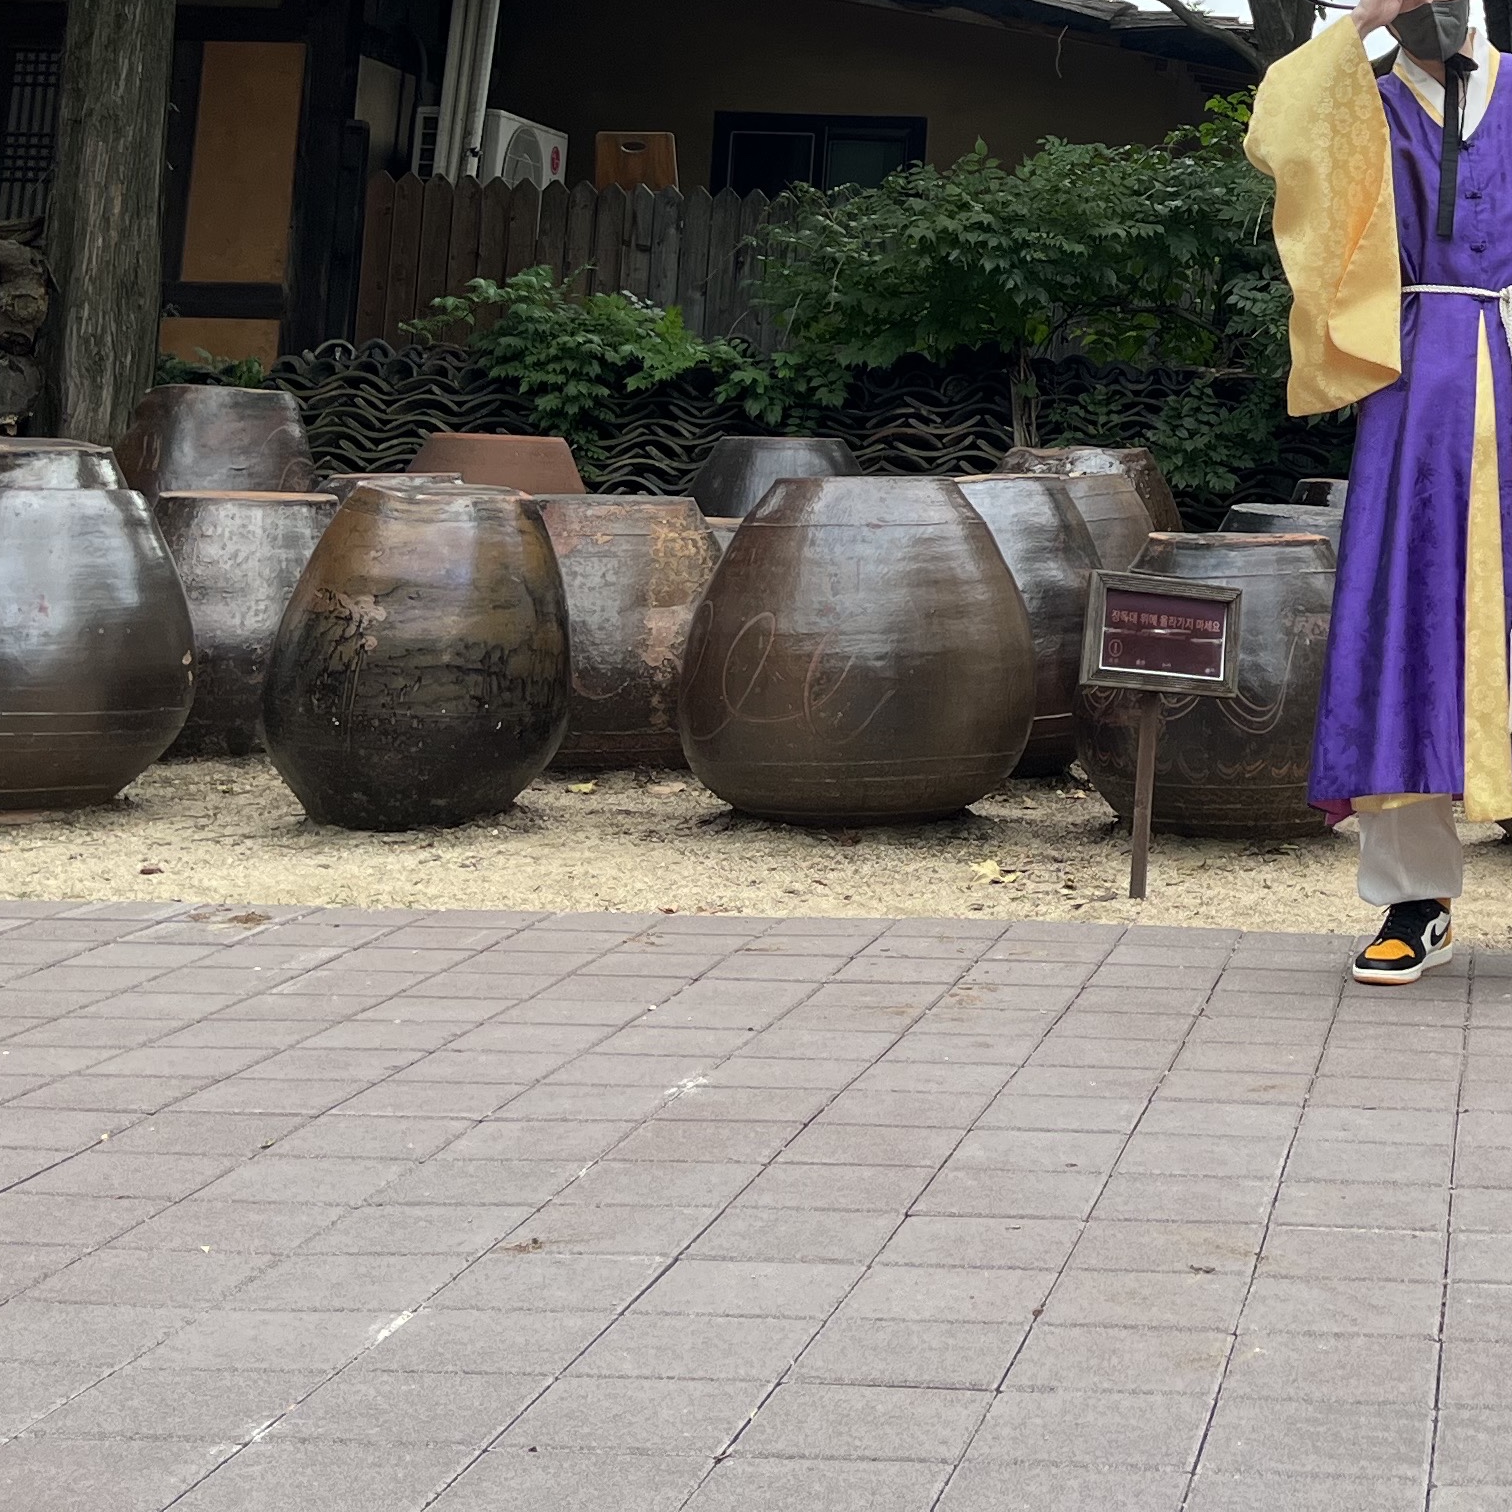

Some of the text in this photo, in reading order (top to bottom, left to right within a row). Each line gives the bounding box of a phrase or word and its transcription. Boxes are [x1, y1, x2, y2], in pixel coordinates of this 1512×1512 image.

[1111, 609, 1221, 632] 장독대 위에 올라가지 마세요
